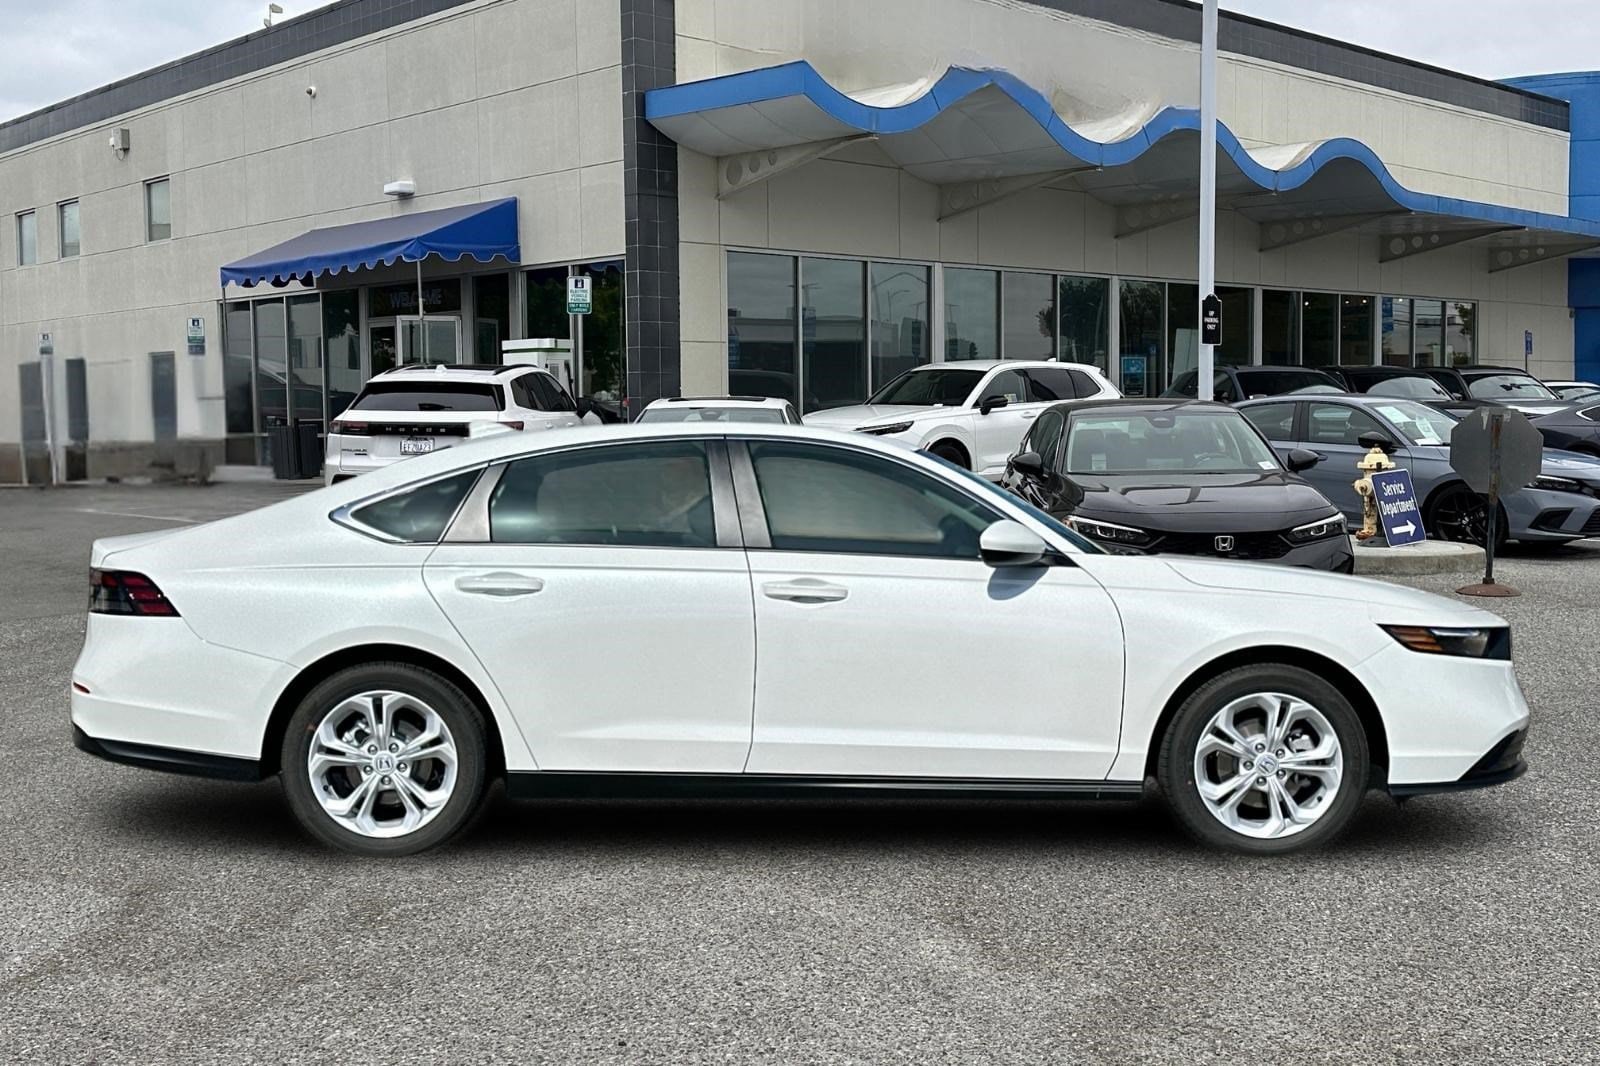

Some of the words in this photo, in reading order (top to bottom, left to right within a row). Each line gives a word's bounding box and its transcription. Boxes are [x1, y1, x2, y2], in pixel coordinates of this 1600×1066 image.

[390, 289, 442, 308] WELCME
[1381, 480, 1406, 497] Service
[1380, 496, 1417, 518] Department
